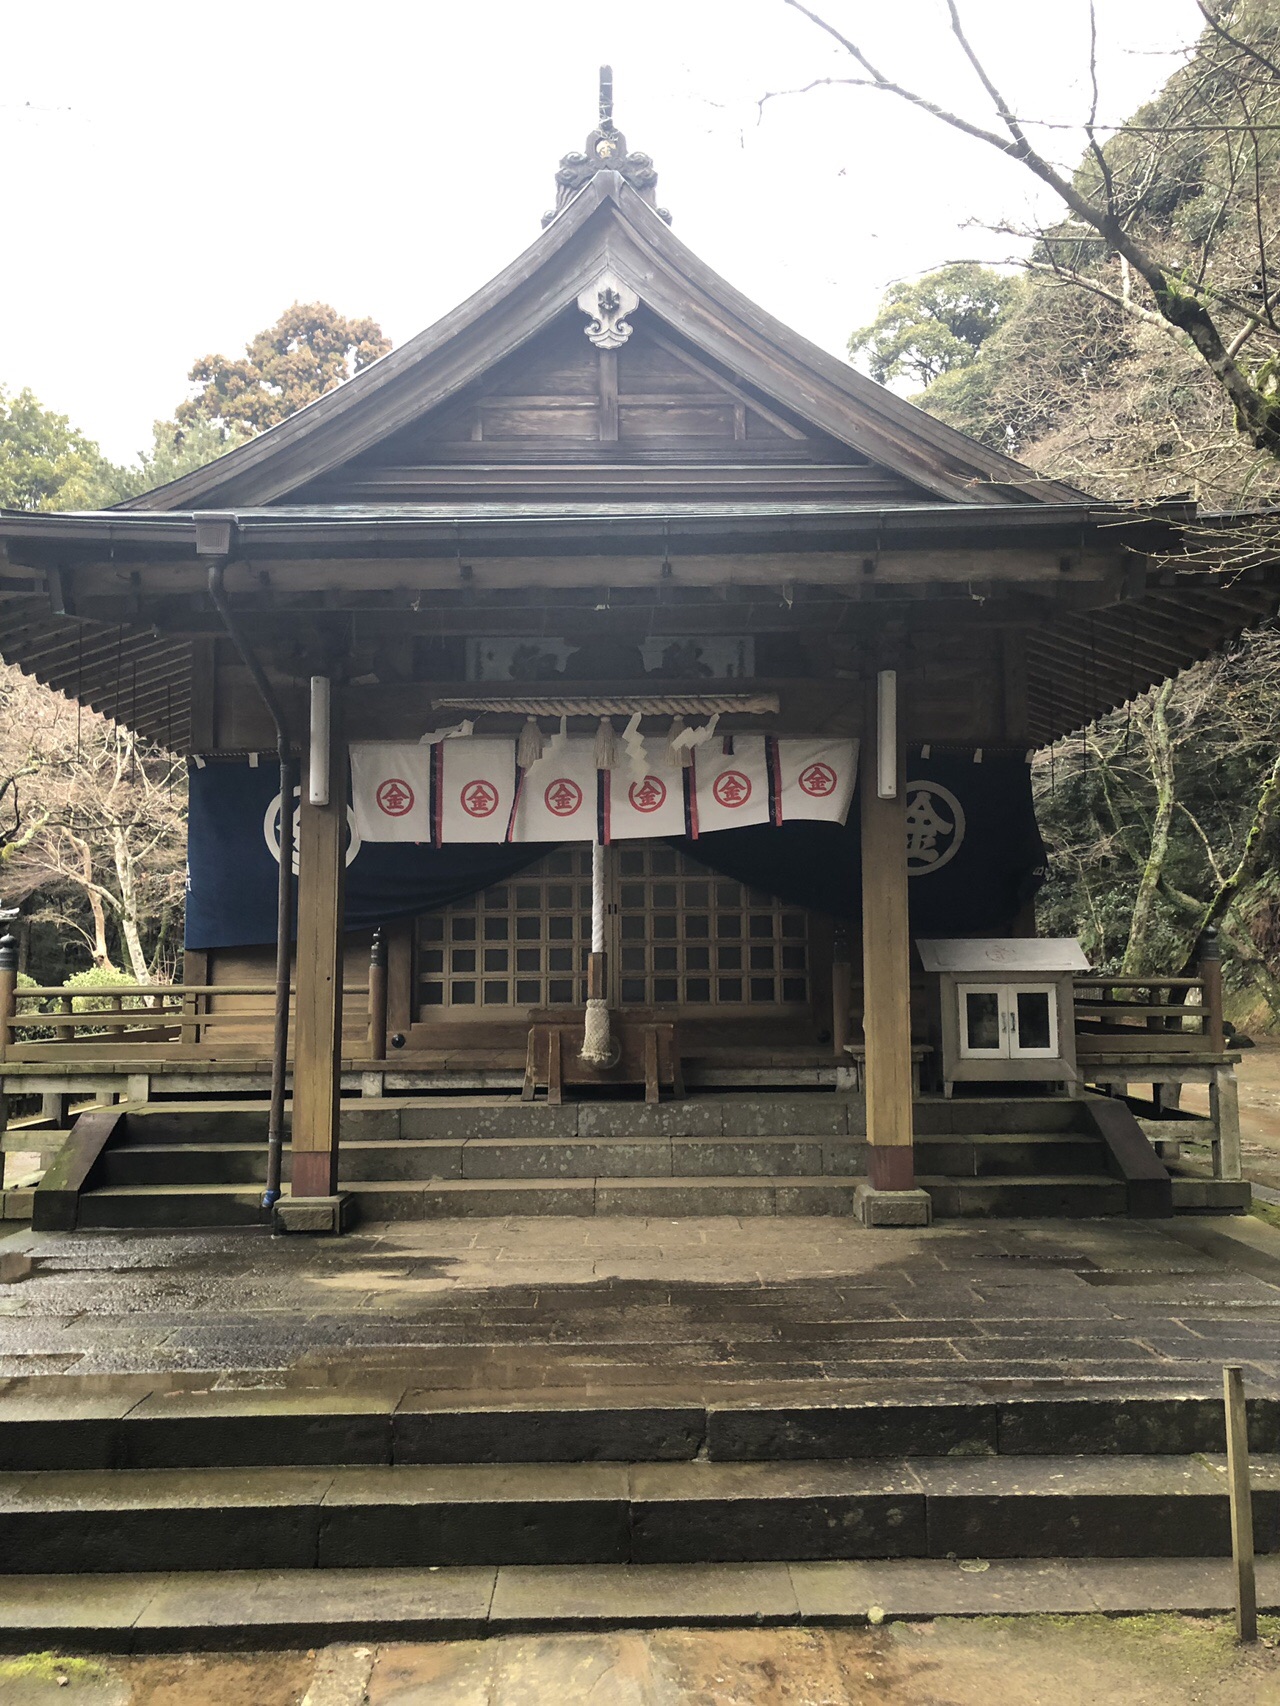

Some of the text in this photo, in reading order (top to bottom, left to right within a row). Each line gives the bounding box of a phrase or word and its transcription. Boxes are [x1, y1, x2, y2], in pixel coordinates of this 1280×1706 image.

[633, 780, 662, 807] 金
[717, 775, 747, 803] 金
[802, 766, 833, 793] 金
[380, 782, 411, 811] 金
[465, 784, 495, 812] 金
[548, 783, 578, 811] 金
[906, 791, 954, 863] 金
